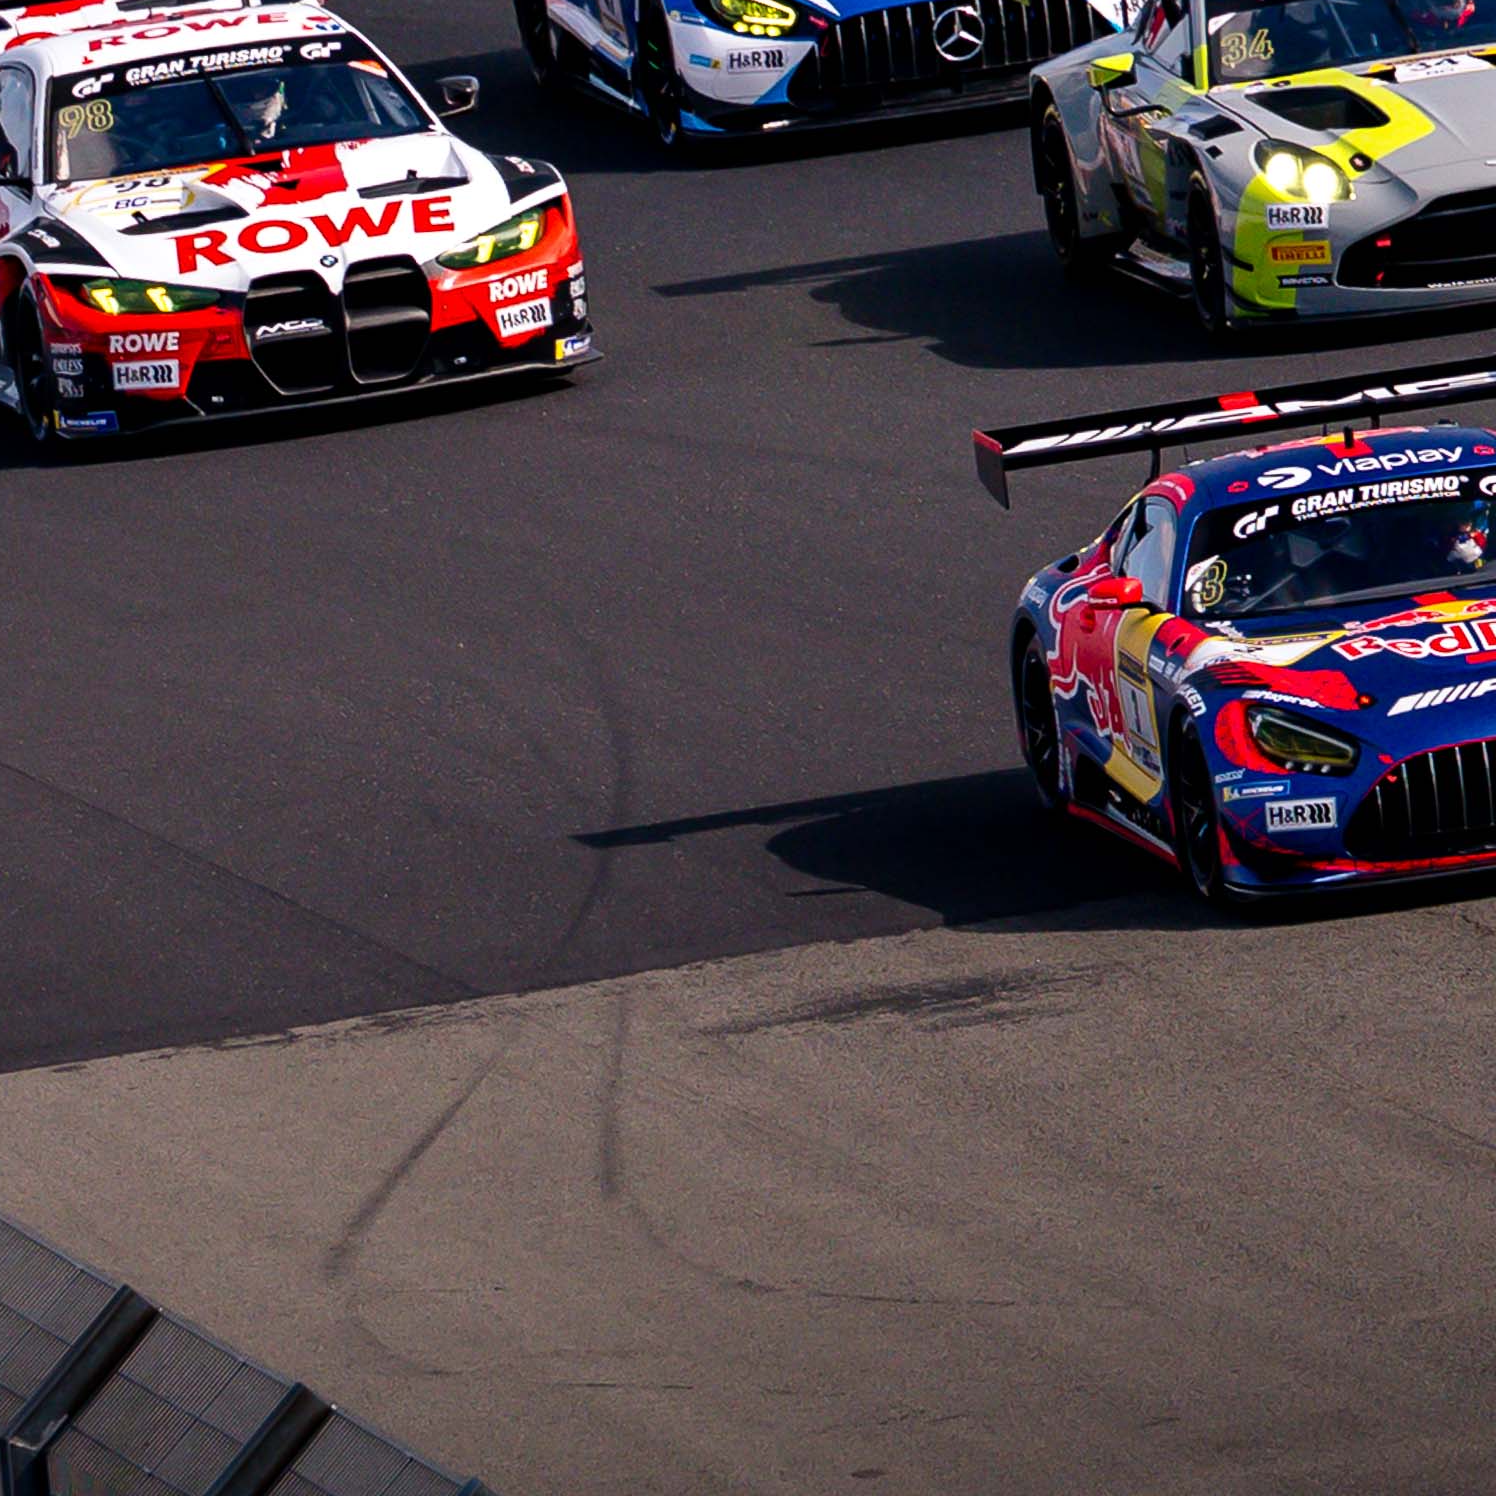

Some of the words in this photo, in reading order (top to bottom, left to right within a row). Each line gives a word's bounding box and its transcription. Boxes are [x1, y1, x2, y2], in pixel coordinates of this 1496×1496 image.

[89, 11, 290, 51] ROWE
[1220, 28, 1274, 67] 34
[125, 58, 185, 86] GRAN
[189, 45, 283, 69] TURISMO
[58, 98, 115, 141] 98
[172, 195, 456, 275] ROWE
[488, 268, 549, 303] ROWE
[109, 331, 180, 354] ROWE
[1316, 445, 1464, 478] viaplay
[1290, 488, 1354, 516] GRAN
[1359, 475, 1461, 502] TURISMO
[1200, 558, 1228, 607] 3
[1332, 621, 1471, 661] Red
